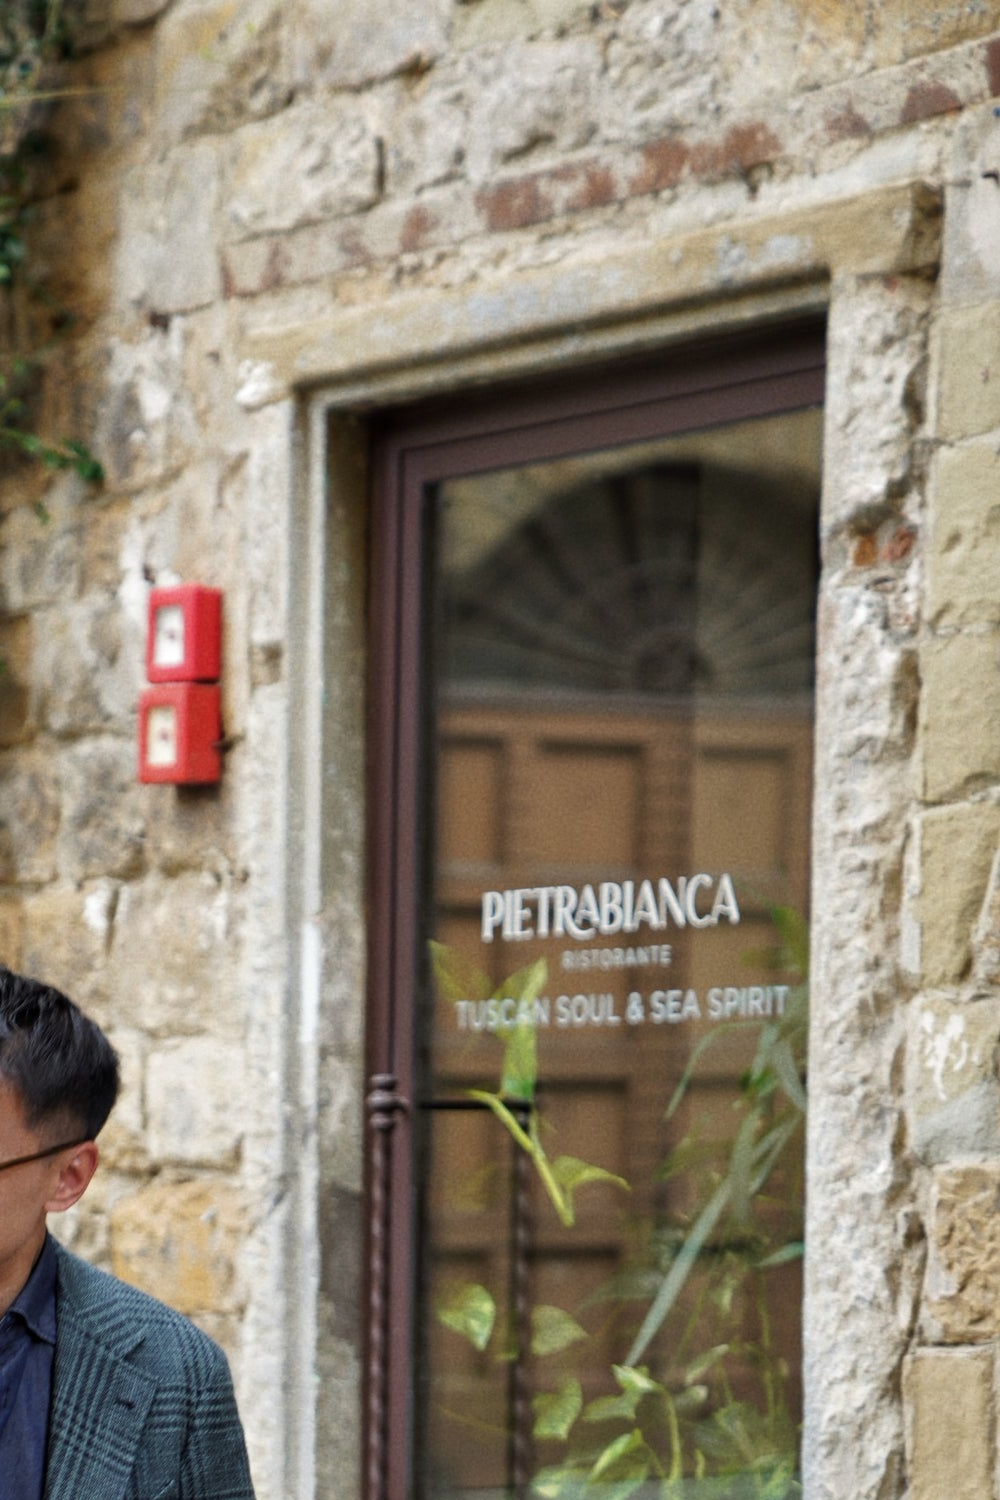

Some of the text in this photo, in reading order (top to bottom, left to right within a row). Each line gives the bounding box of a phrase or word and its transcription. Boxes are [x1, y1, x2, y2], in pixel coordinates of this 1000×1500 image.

[480, 873, 740, 943] PIETRABIANCA
[455, 985, 789, 1031] TUSCAN SOUL & SEA SPIRIT
